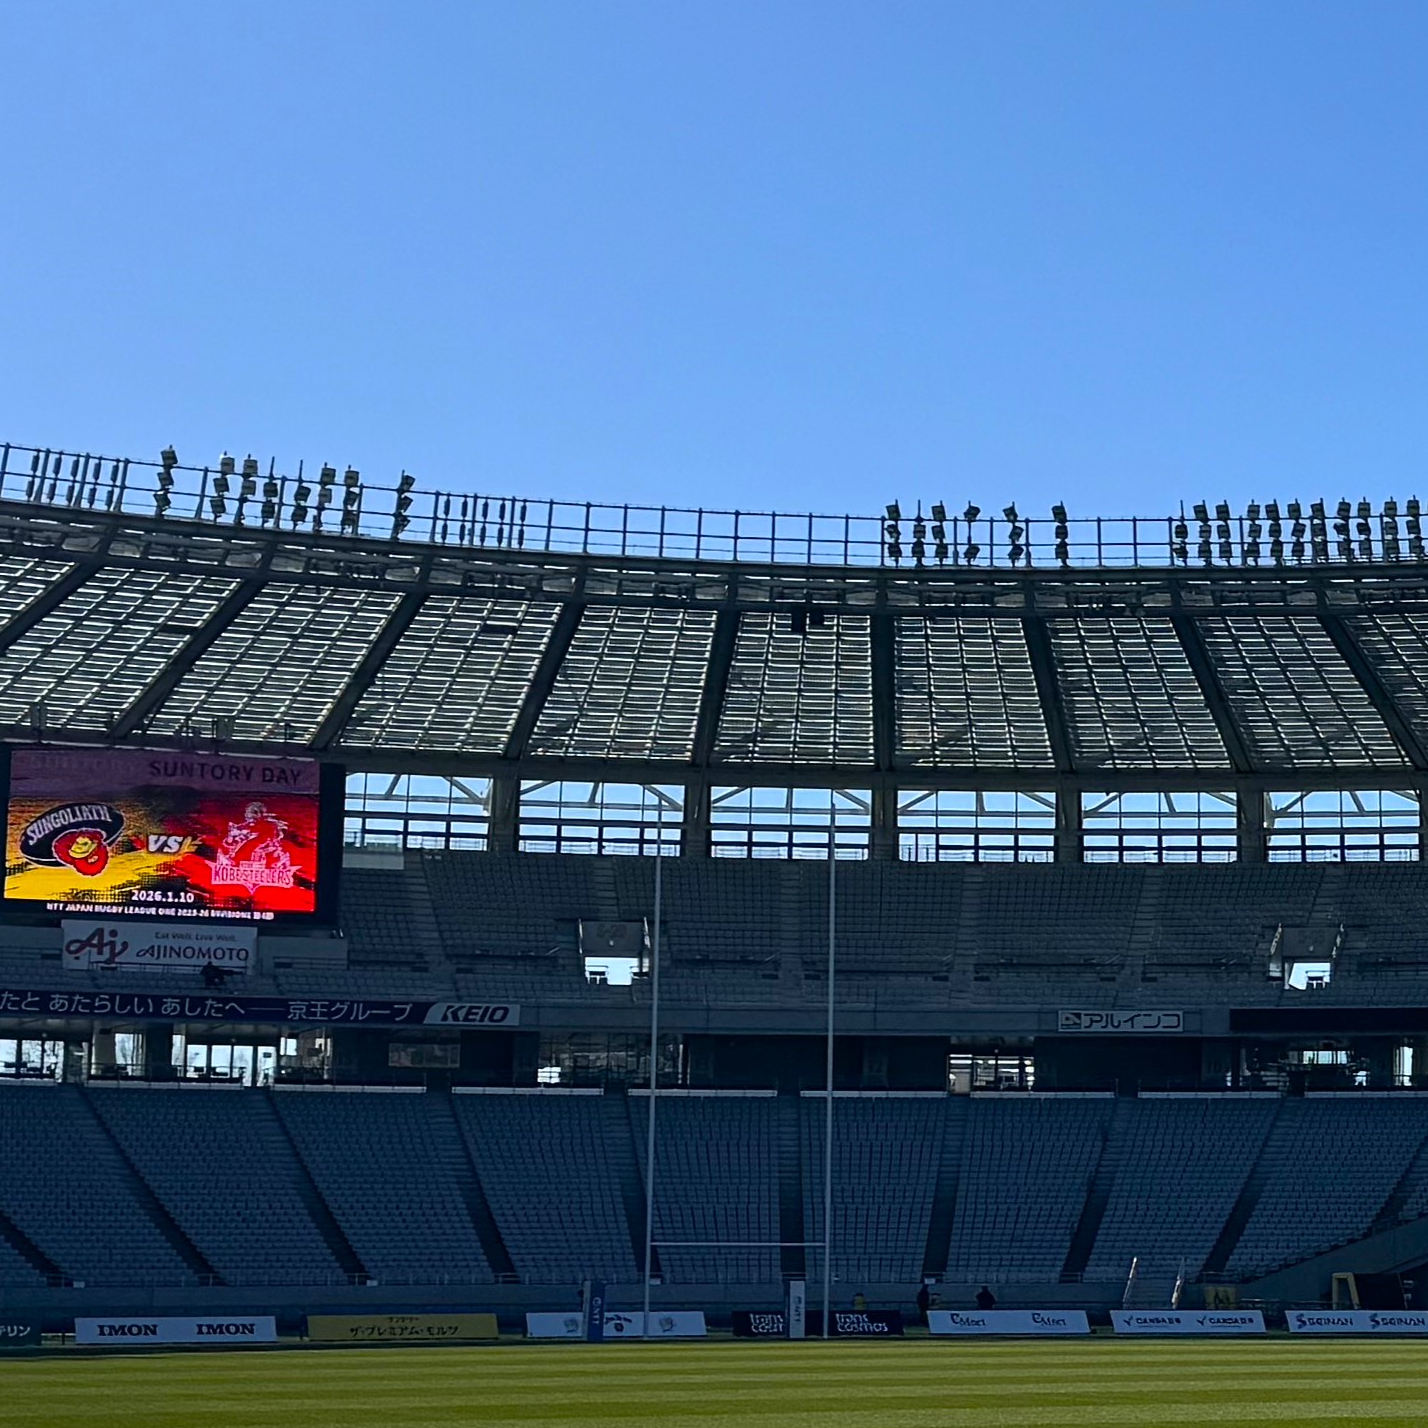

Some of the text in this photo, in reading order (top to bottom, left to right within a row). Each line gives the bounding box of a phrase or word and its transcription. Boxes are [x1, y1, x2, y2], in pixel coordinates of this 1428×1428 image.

[149, 760, 301, 786] SUNTORY DAY
[26, 805, 112, 846] SUNGOLIATH
[131, 890, 195, 903] 2026.1.10
[65, 903, 93, 912] JAPAN
[94, 904, 123, 914] RUGBY
[124, 905, 156, 915] LEAGUE
[158, 907, 175, 916] ONE
[155, 931, 170, 940] Eat
[172, 932, 192, 941] Well.
[195, 932, 213, 941] Live
[136, 945, 249, 961] AJINOMOTO
[49, 993, 153, 1015] あたらしい
[288, 1000, 413, 1021] 京王グループ
[441, 1005, 509, 1023] KEIO
[1084, 1013, 1181, 1029] アルインコ
[835, 1313, 869, 1324] trans
[97, 1324, 158, 1336] IMON
[196, 1323, 255, 1335] IMON
[837, 1322, 889, 1333] cosmos
